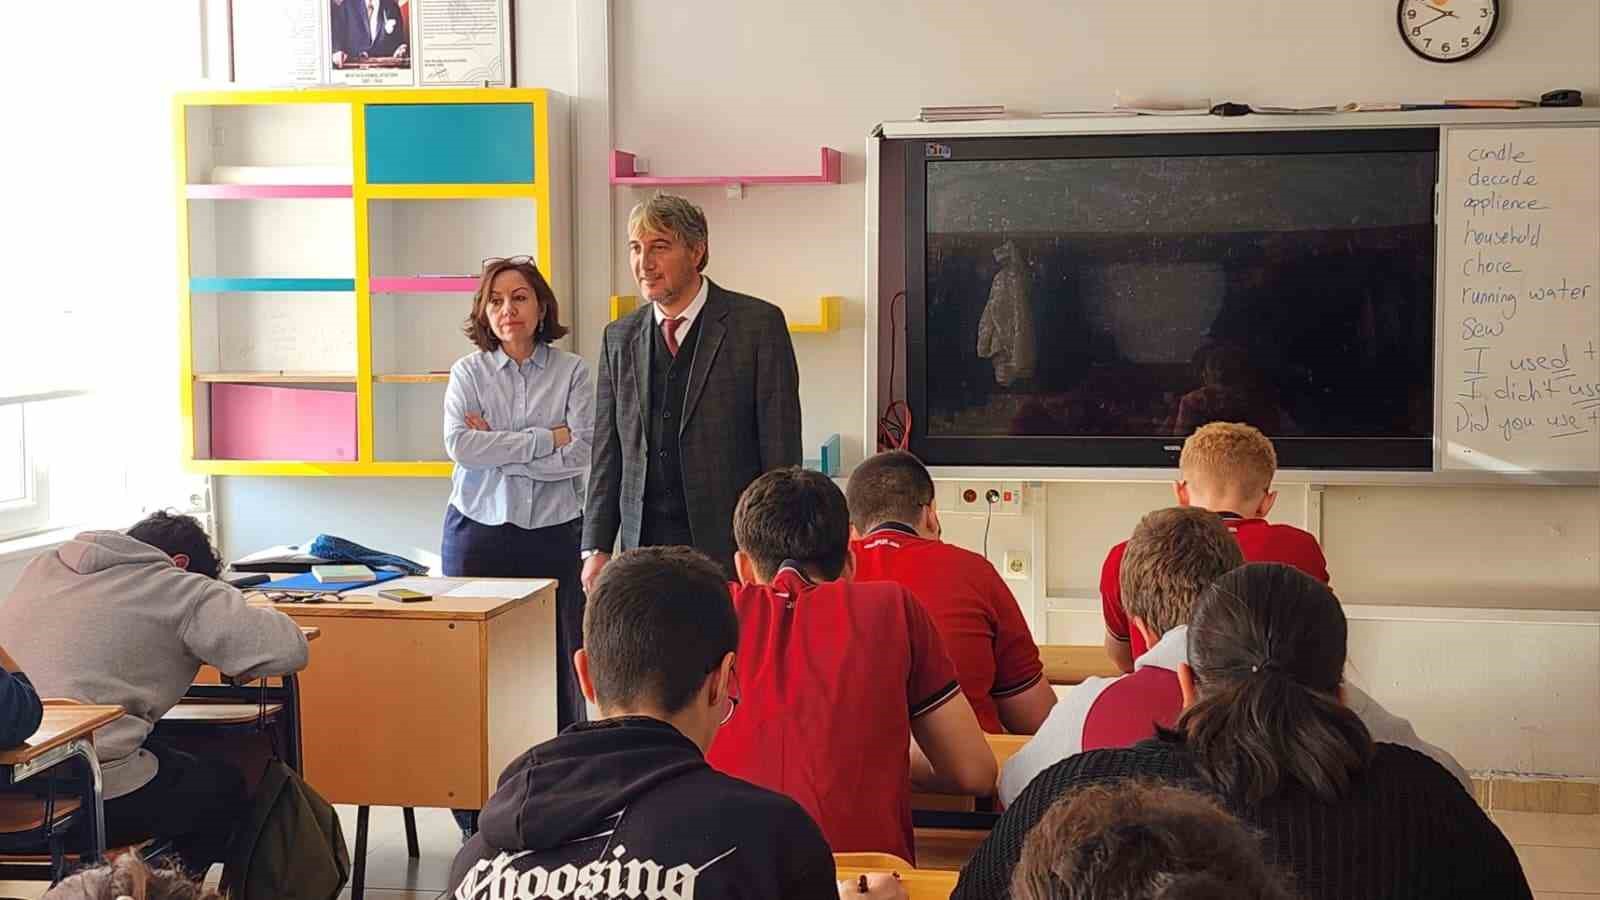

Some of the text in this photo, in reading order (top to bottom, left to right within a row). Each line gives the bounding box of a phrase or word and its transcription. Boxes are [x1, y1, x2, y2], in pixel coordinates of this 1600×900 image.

[1407, 9, 1417, 20] 9
[1480, 8, 1488, 18] 3
[1473, 25, 1481, 35] 4
[1423, 38, 1432, 48] 7
[1441, 42, 1450, 53] 6
[1461, 37, 1470, 48] 5
[1468, 142, 1536, 163] candle
[1468, 166, 1538, 186] decade
[1464, 191, 1549, 216] applience
[1464, 220, 1541, 248] household
[1462, 277, 1592, 320] running water
[1463, 346, 1491, 374] I
[1510, 343, 1569, 371] used
[1456, 401, 1489, 433] Did
[1503, 416, 1534, 441] you
[1546, 413, 1583, 430] use
